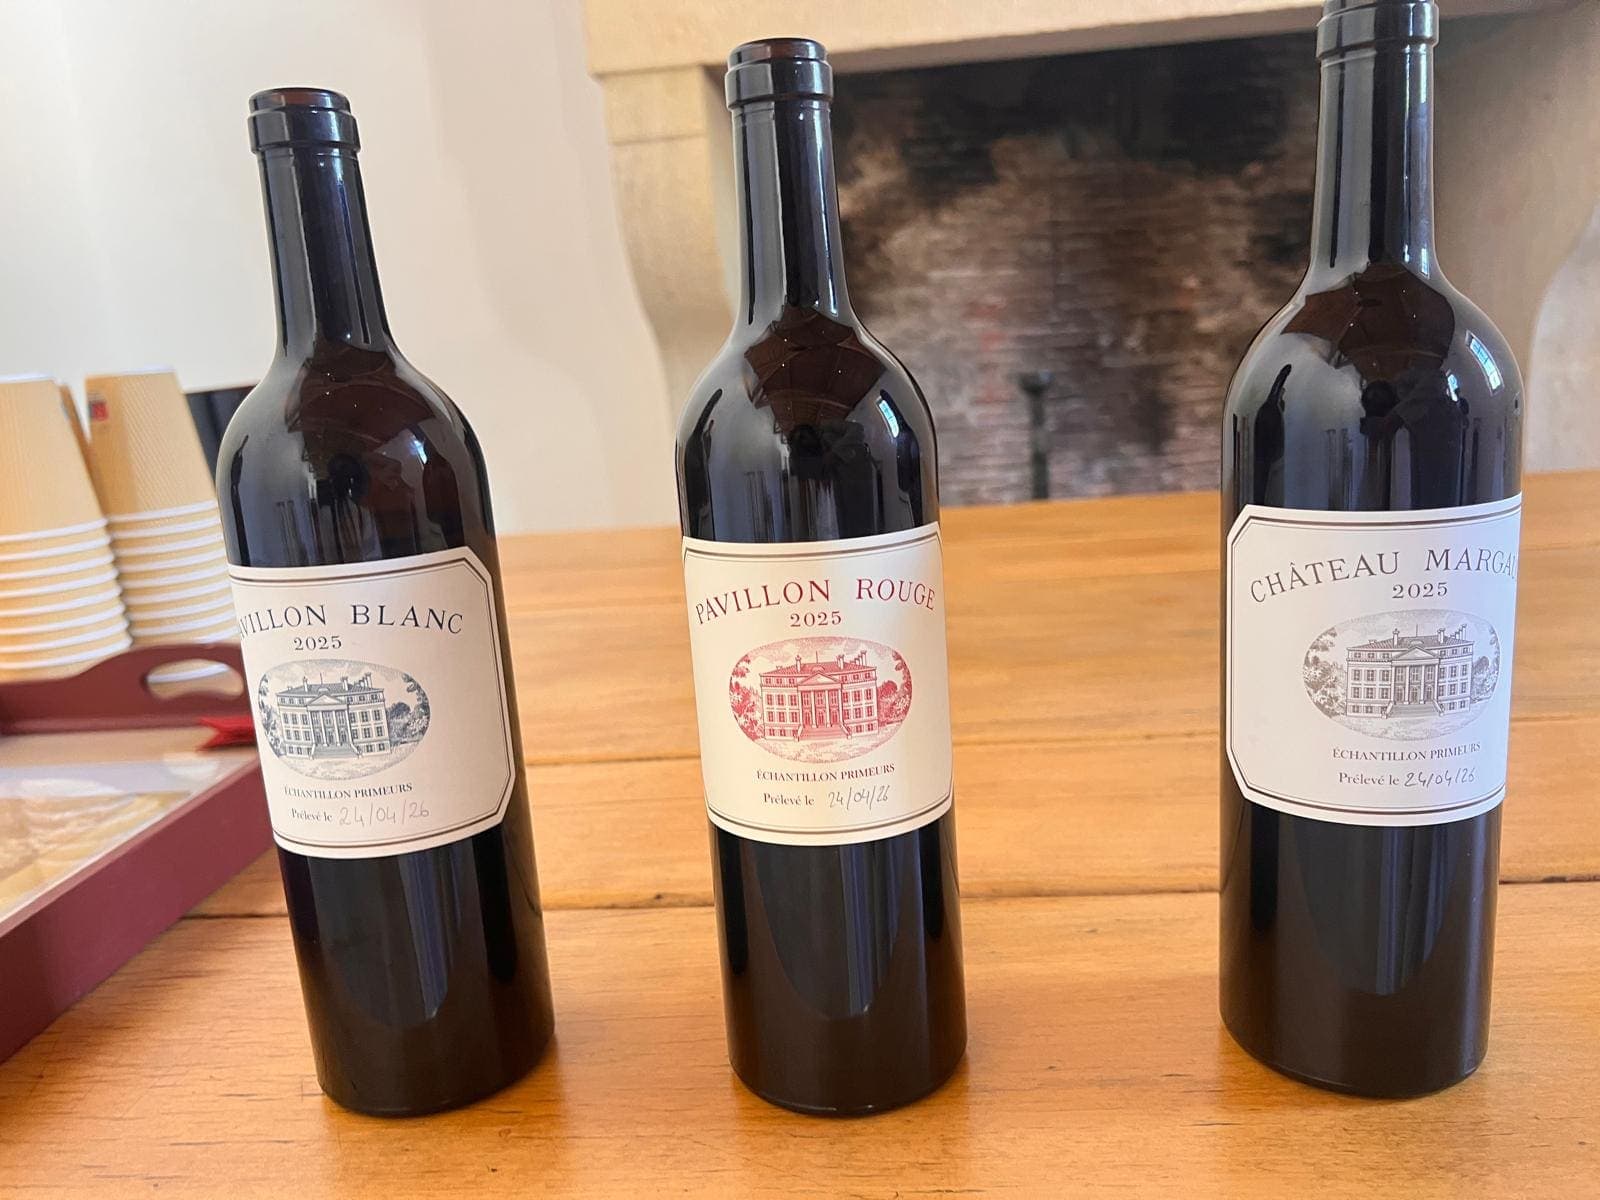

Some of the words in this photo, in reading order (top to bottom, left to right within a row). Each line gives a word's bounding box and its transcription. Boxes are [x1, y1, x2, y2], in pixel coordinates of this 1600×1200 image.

[1250, 551, 1400, 603] CHÂTEAU
[1392, 582, 1448, 599] 2025
[695, 579, 831, 625] PAVILLON
[856, 578, 935, 611] ROUGE
[350, 604, 463, 634] BLANC
[789, 611, 842, 628] 2025
[293, 635, 342, 651] 2025
[1333, 747, 1427, 761] ÉCHANTILLON
[1430, 742, 1481, 760] PRIMEURS
[756, 769, 837, 782] ÉCHANTILLON
[840, 763, 895, 780] PRIMEURS
[1339, 771, 1385, 786] Prélevé
[1389, 774, 1400, 786] le
[1404, 767, 1476, 789] 24/04/26
[354, 782, 413, 798] PRIMEURS
[763, 792, 801, 806] Prélevé
[804, 795, 815, 806] le
[828, 784, 890, 810] 24/04/26
[291, 807, 321, 821] Prélevé
[323, 811, 333, 822] le
[339, 799, 430, 827] 24/04/26
